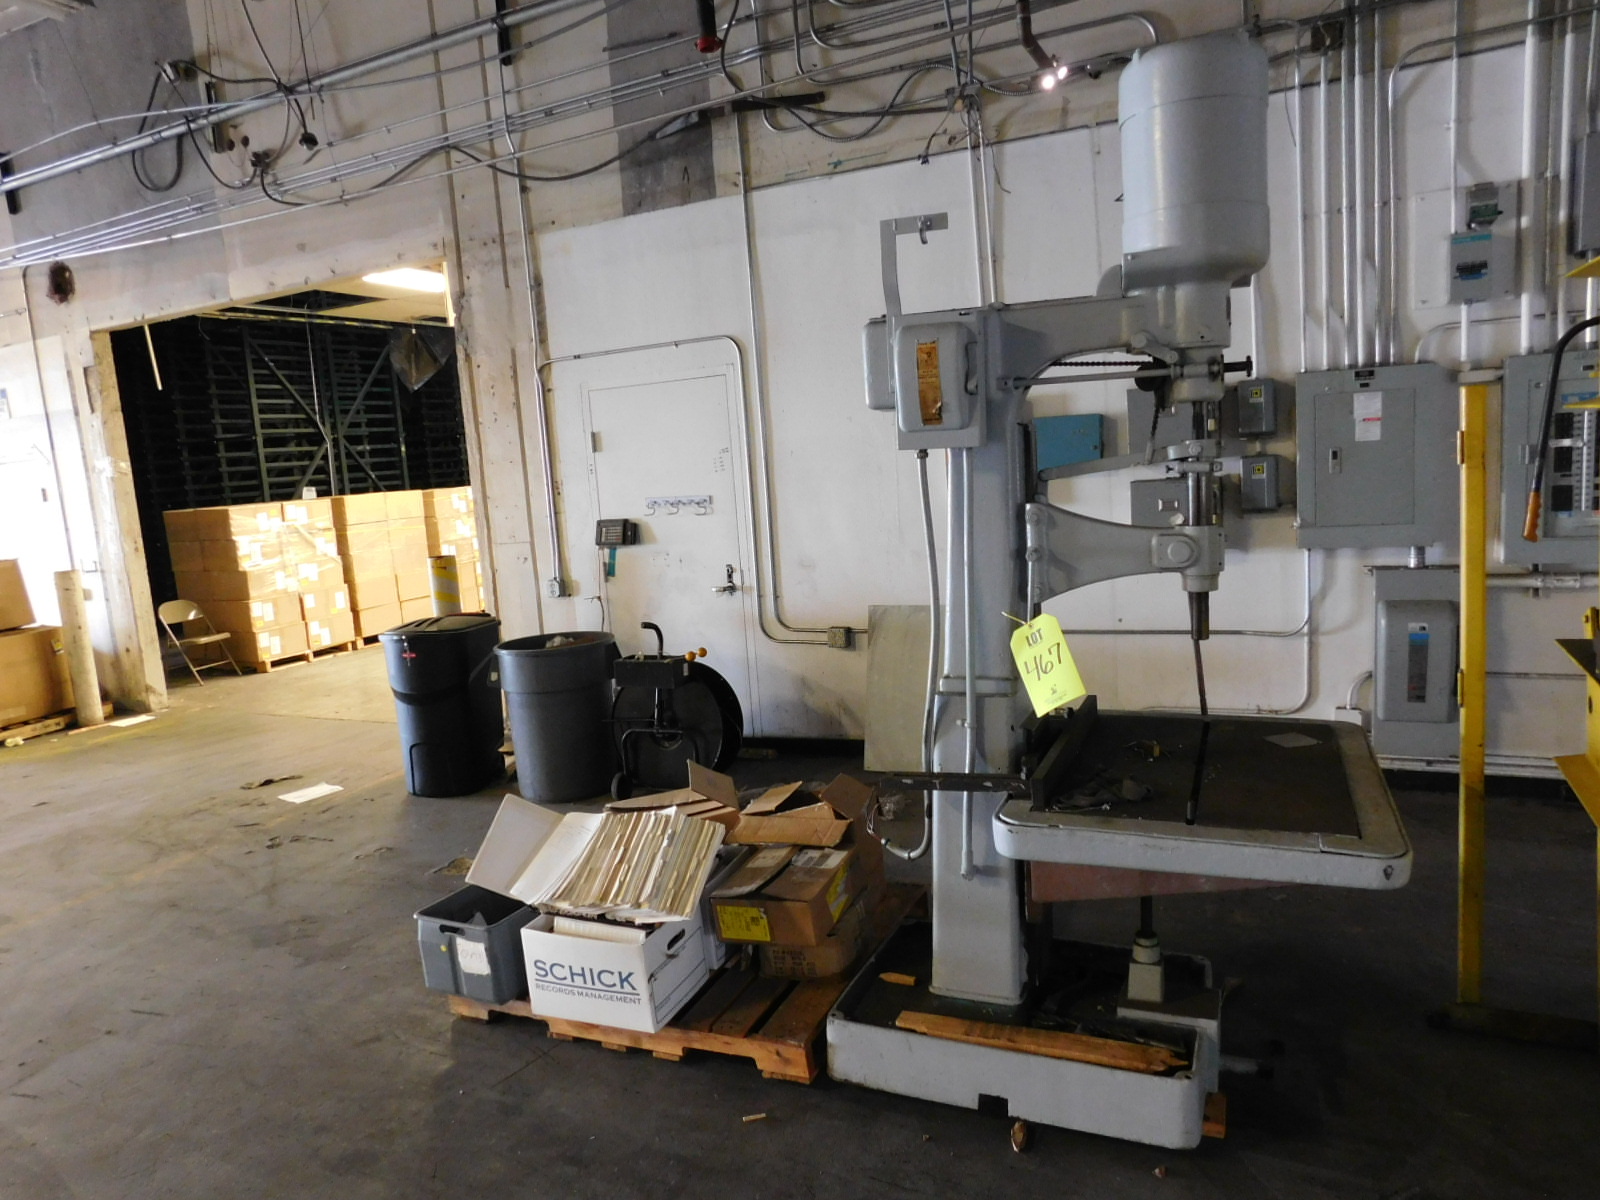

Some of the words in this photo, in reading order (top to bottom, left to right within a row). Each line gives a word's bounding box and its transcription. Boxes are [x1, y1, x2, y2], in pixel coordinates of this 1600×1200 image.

[1025, 628, 1043, 647] LOT
[1024, 642, 1062, 681] 467
[533, 958, 638, 992] SCHICK
[535, 983, 576, 997] RECORDS
[577, 991, 642, 1006] MANAGEMENT
